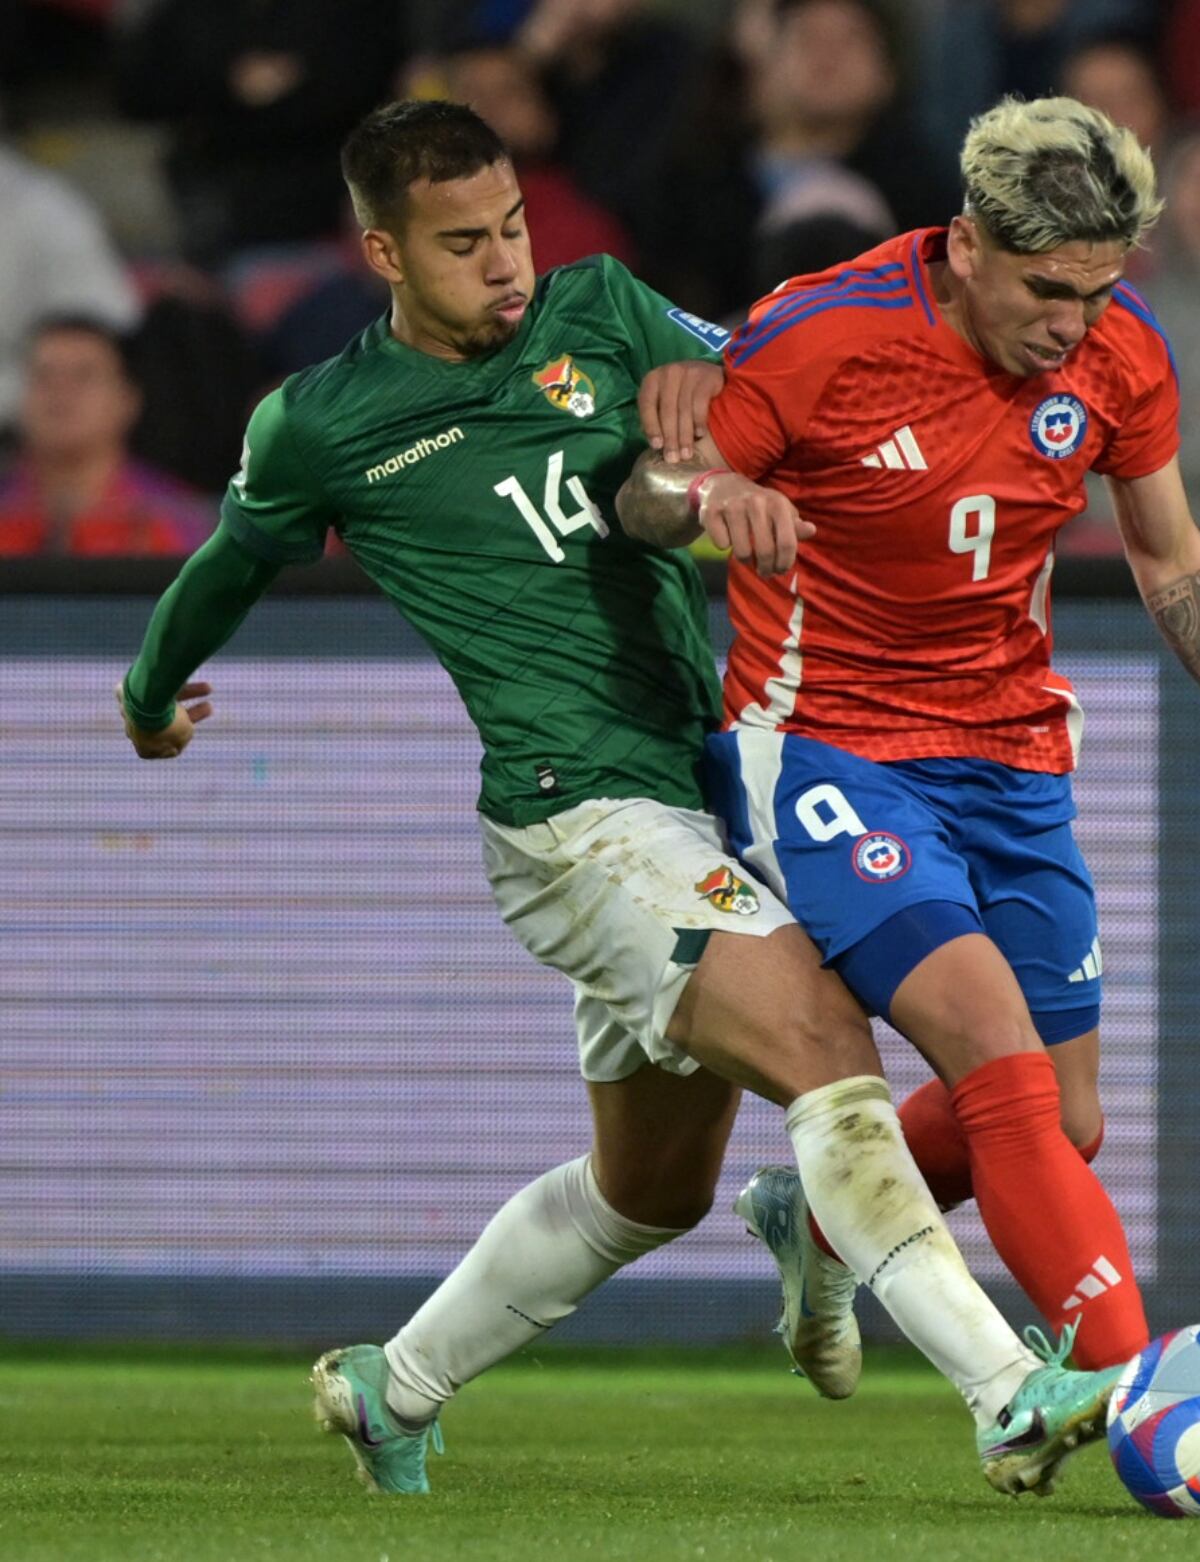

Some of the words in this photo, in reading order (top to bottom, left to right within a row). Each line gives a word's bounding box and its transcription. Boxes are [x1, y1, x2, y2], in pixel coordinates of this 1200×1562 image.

[365, 426, 465, 484] marathon
[493, 449, 610, 564] 14
[948, 493, 997, 582] 9
[794, 783, 870, 843] 9
